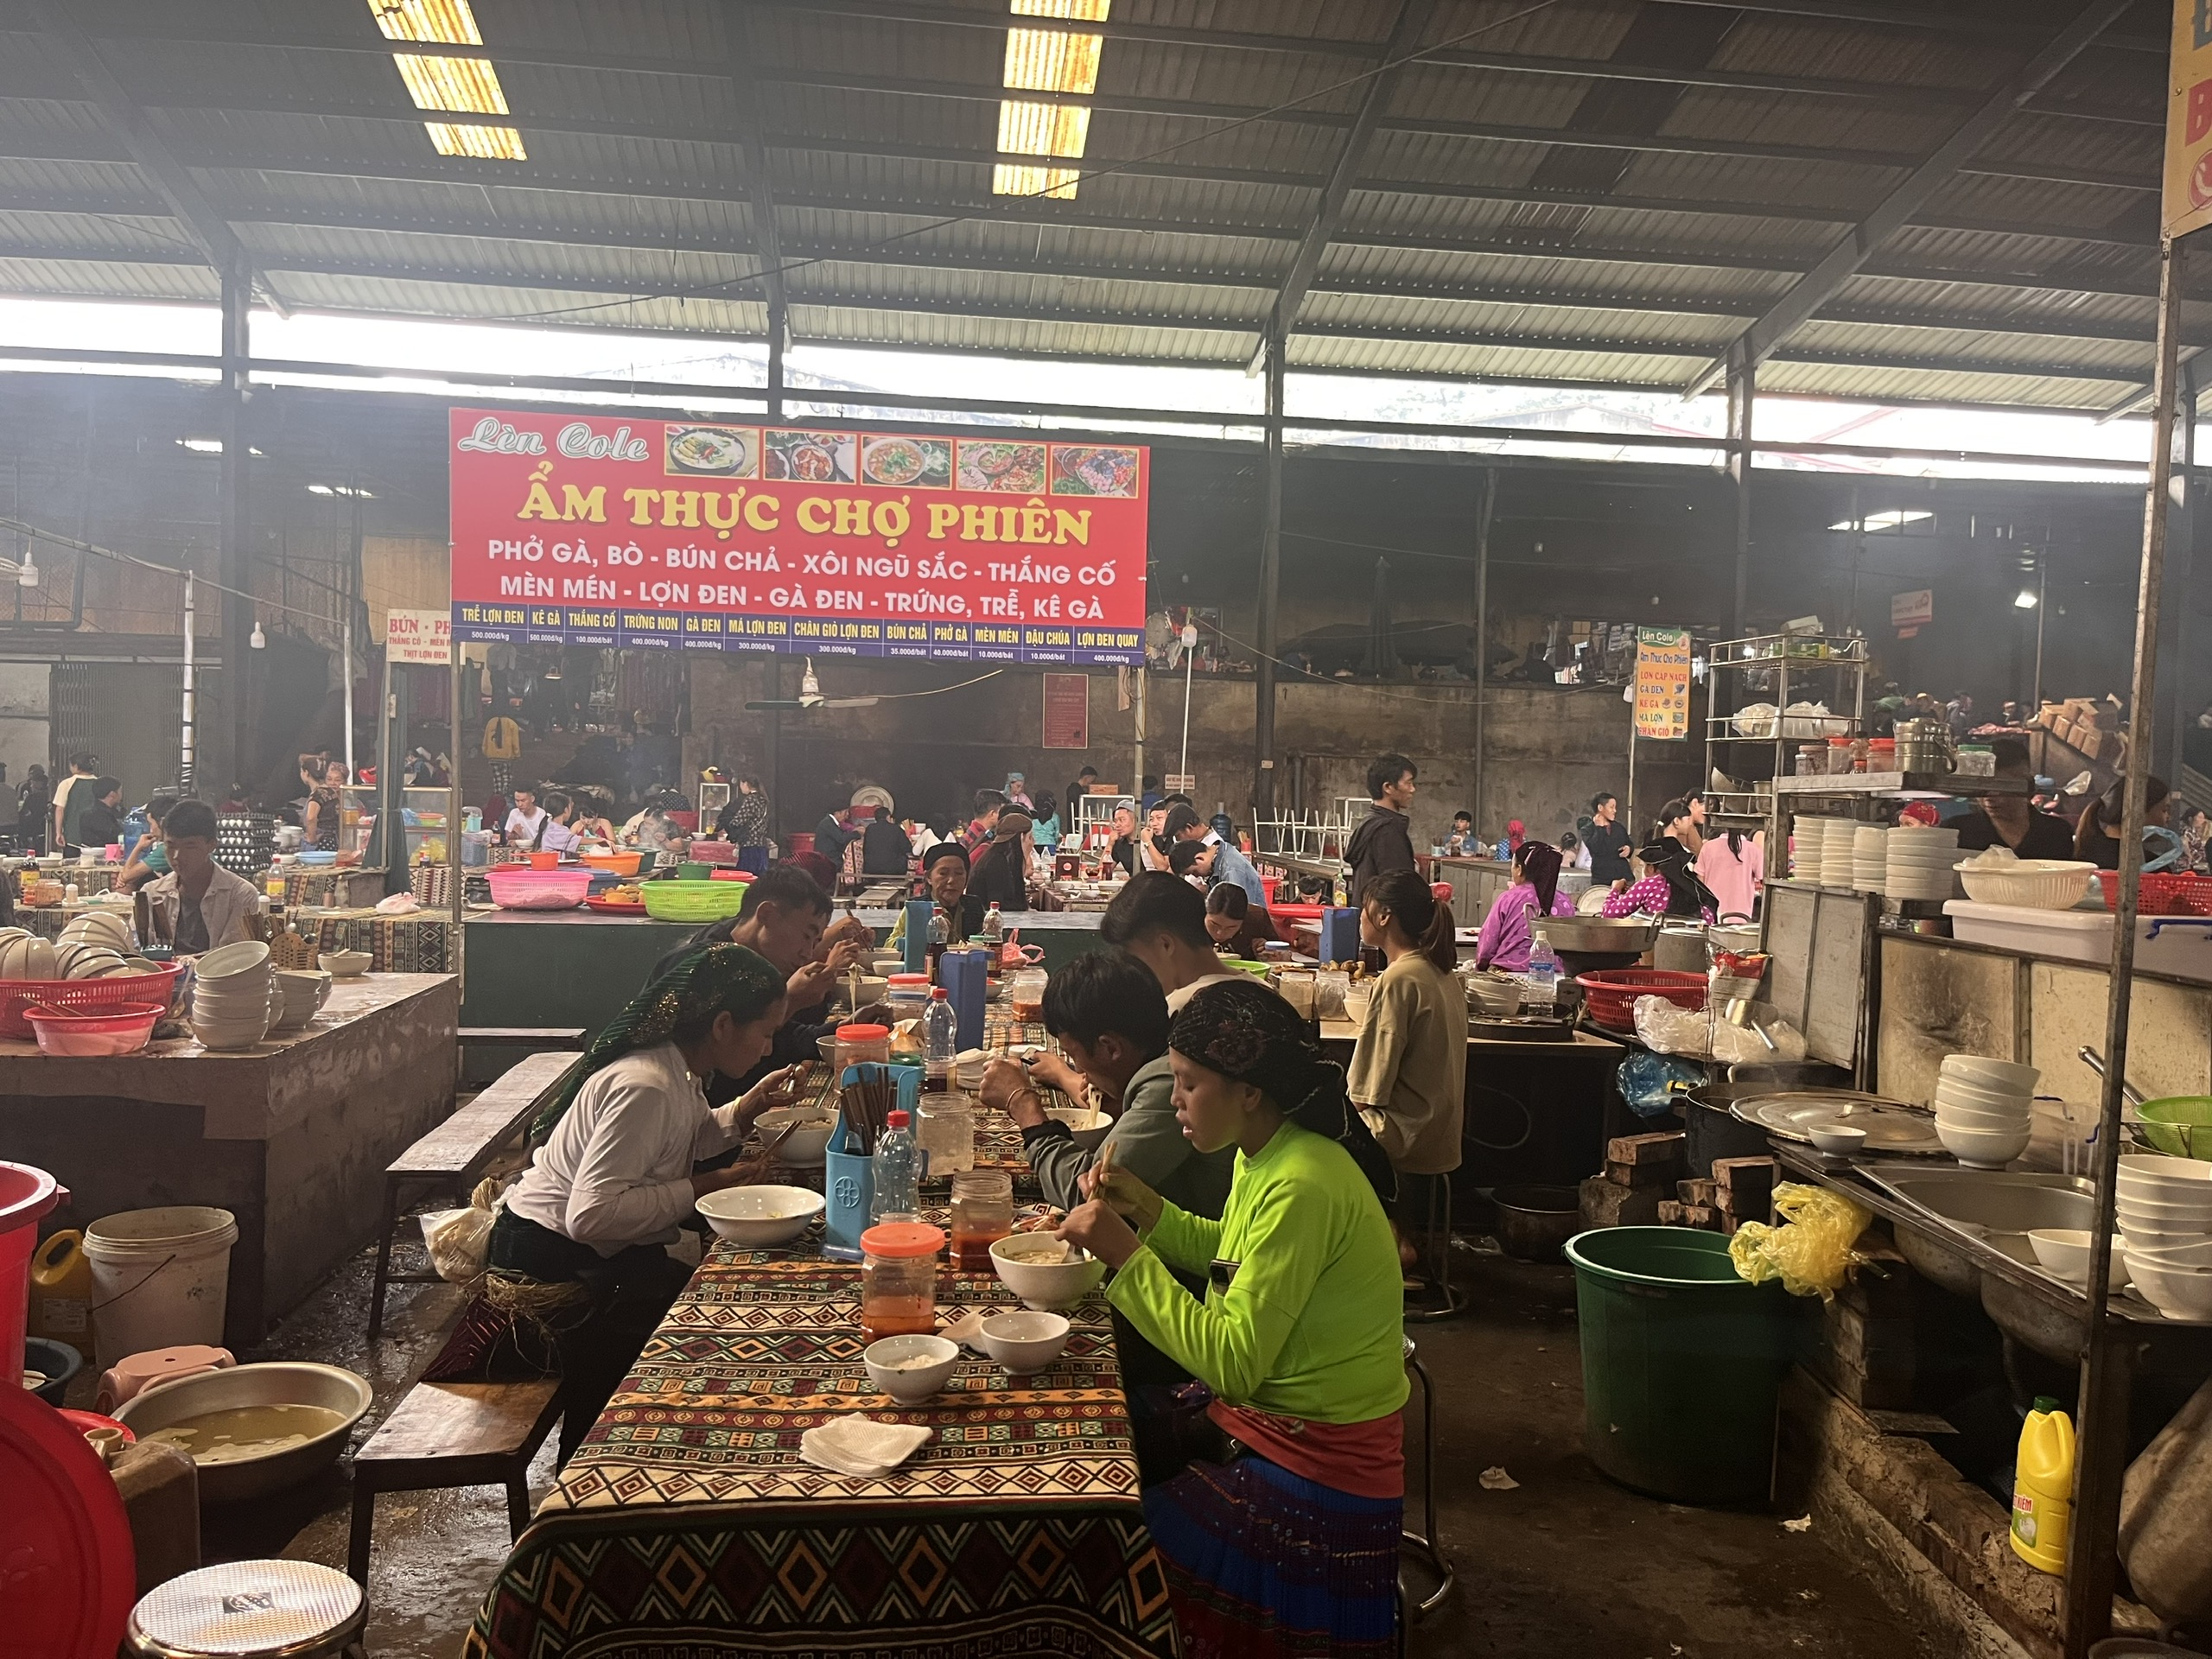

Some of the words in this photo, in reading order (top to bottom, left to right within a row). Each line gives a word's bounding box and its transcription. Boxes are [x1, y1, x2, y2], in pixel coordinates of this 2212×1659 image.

[458, 416, 547, 455] Lèn
[556, 423, 650, 461] Cole
[518, 461, 607, 523] ẨM
[624, 486, 779, 540] THỰC
[797, 495, 910, 548] CHỢ
[926, 498, 1092, 545] PHIÊN
[488, 536, 543, 562] PHỞ
[552, 538, 598, 568] GÀ,
[607, 541, 643, 567] BÒ
[666, 544, 716, 569] BÚN
[724, 546, 780, 572] CHẢ
[803, 550, 848, 576] XÔI
[857, 554, 910, 577] NGŨ
[917, 551, 967, 580] SẮC
[988, 555, 1071, 584] THẮNG
[1078, 560, 1116, 587] CỐ
[501, 572, 554, 597] MÈN
[563, 575, 616, 600] MÉN
[639, 580, 690, 607] LỢN
[698, 586, 747, 605] ĐEN
[769, 583, 807, 608] GÀ
[817, 590, 863, 611] ĐEN
[885, 588, 972, 618] TRỨNG,
[1034, 594, 1060, 618] KÊ
[1068, 595, 1104, 620] GÀ
[389, 614, 419, 633] BÚN
[483, 608, 502, 626] LỢN
[505, 610, 524, 624] ĐEN
[532, 609, 544, 625] KÊ
[547, 610, 561, 626] GÀ
[569, 609, 601, 626] THẮNG
[603, 610, 616, 627] CỐ
[624, 613, 655, 629] TRỨNG
[658, 617, 678, 631] NON
[686, 616, 699, 632] GÀ
[702, 619, 721, 632] ĐEN
[728, 618, 744, 632] MÁ
[747, 620, 765, 636] LỢN
[767, 621, 786, 635] ĐEN
[794, 620, 820, 636] CHÂN
[823, 621, 838, 637] GIÒ
[840, 624, 858, 640] LỢN
[861, 625, 880, 639] ĐEN
[887, 624, 906, 639] BÚN
[909, 623, 927, 640] CHẢ
[935, 624, 953, 641] PHỞ
[955, 626, 968, 642] GÀ
[975, 626, 995, 643] MÈN
[998, 627, 1019, 644] MÉN
[1026, 629, 1044, 647] ĐẬU
[1046, 630, 1071, 645] CHÚA
[1077, 632, 1095, 648] LỢN
[1096, 633, 1115, 646] ĐEN
[1116, 634, 1139, 647] QUAY
[1656, 632, 1674, 642] Cole
